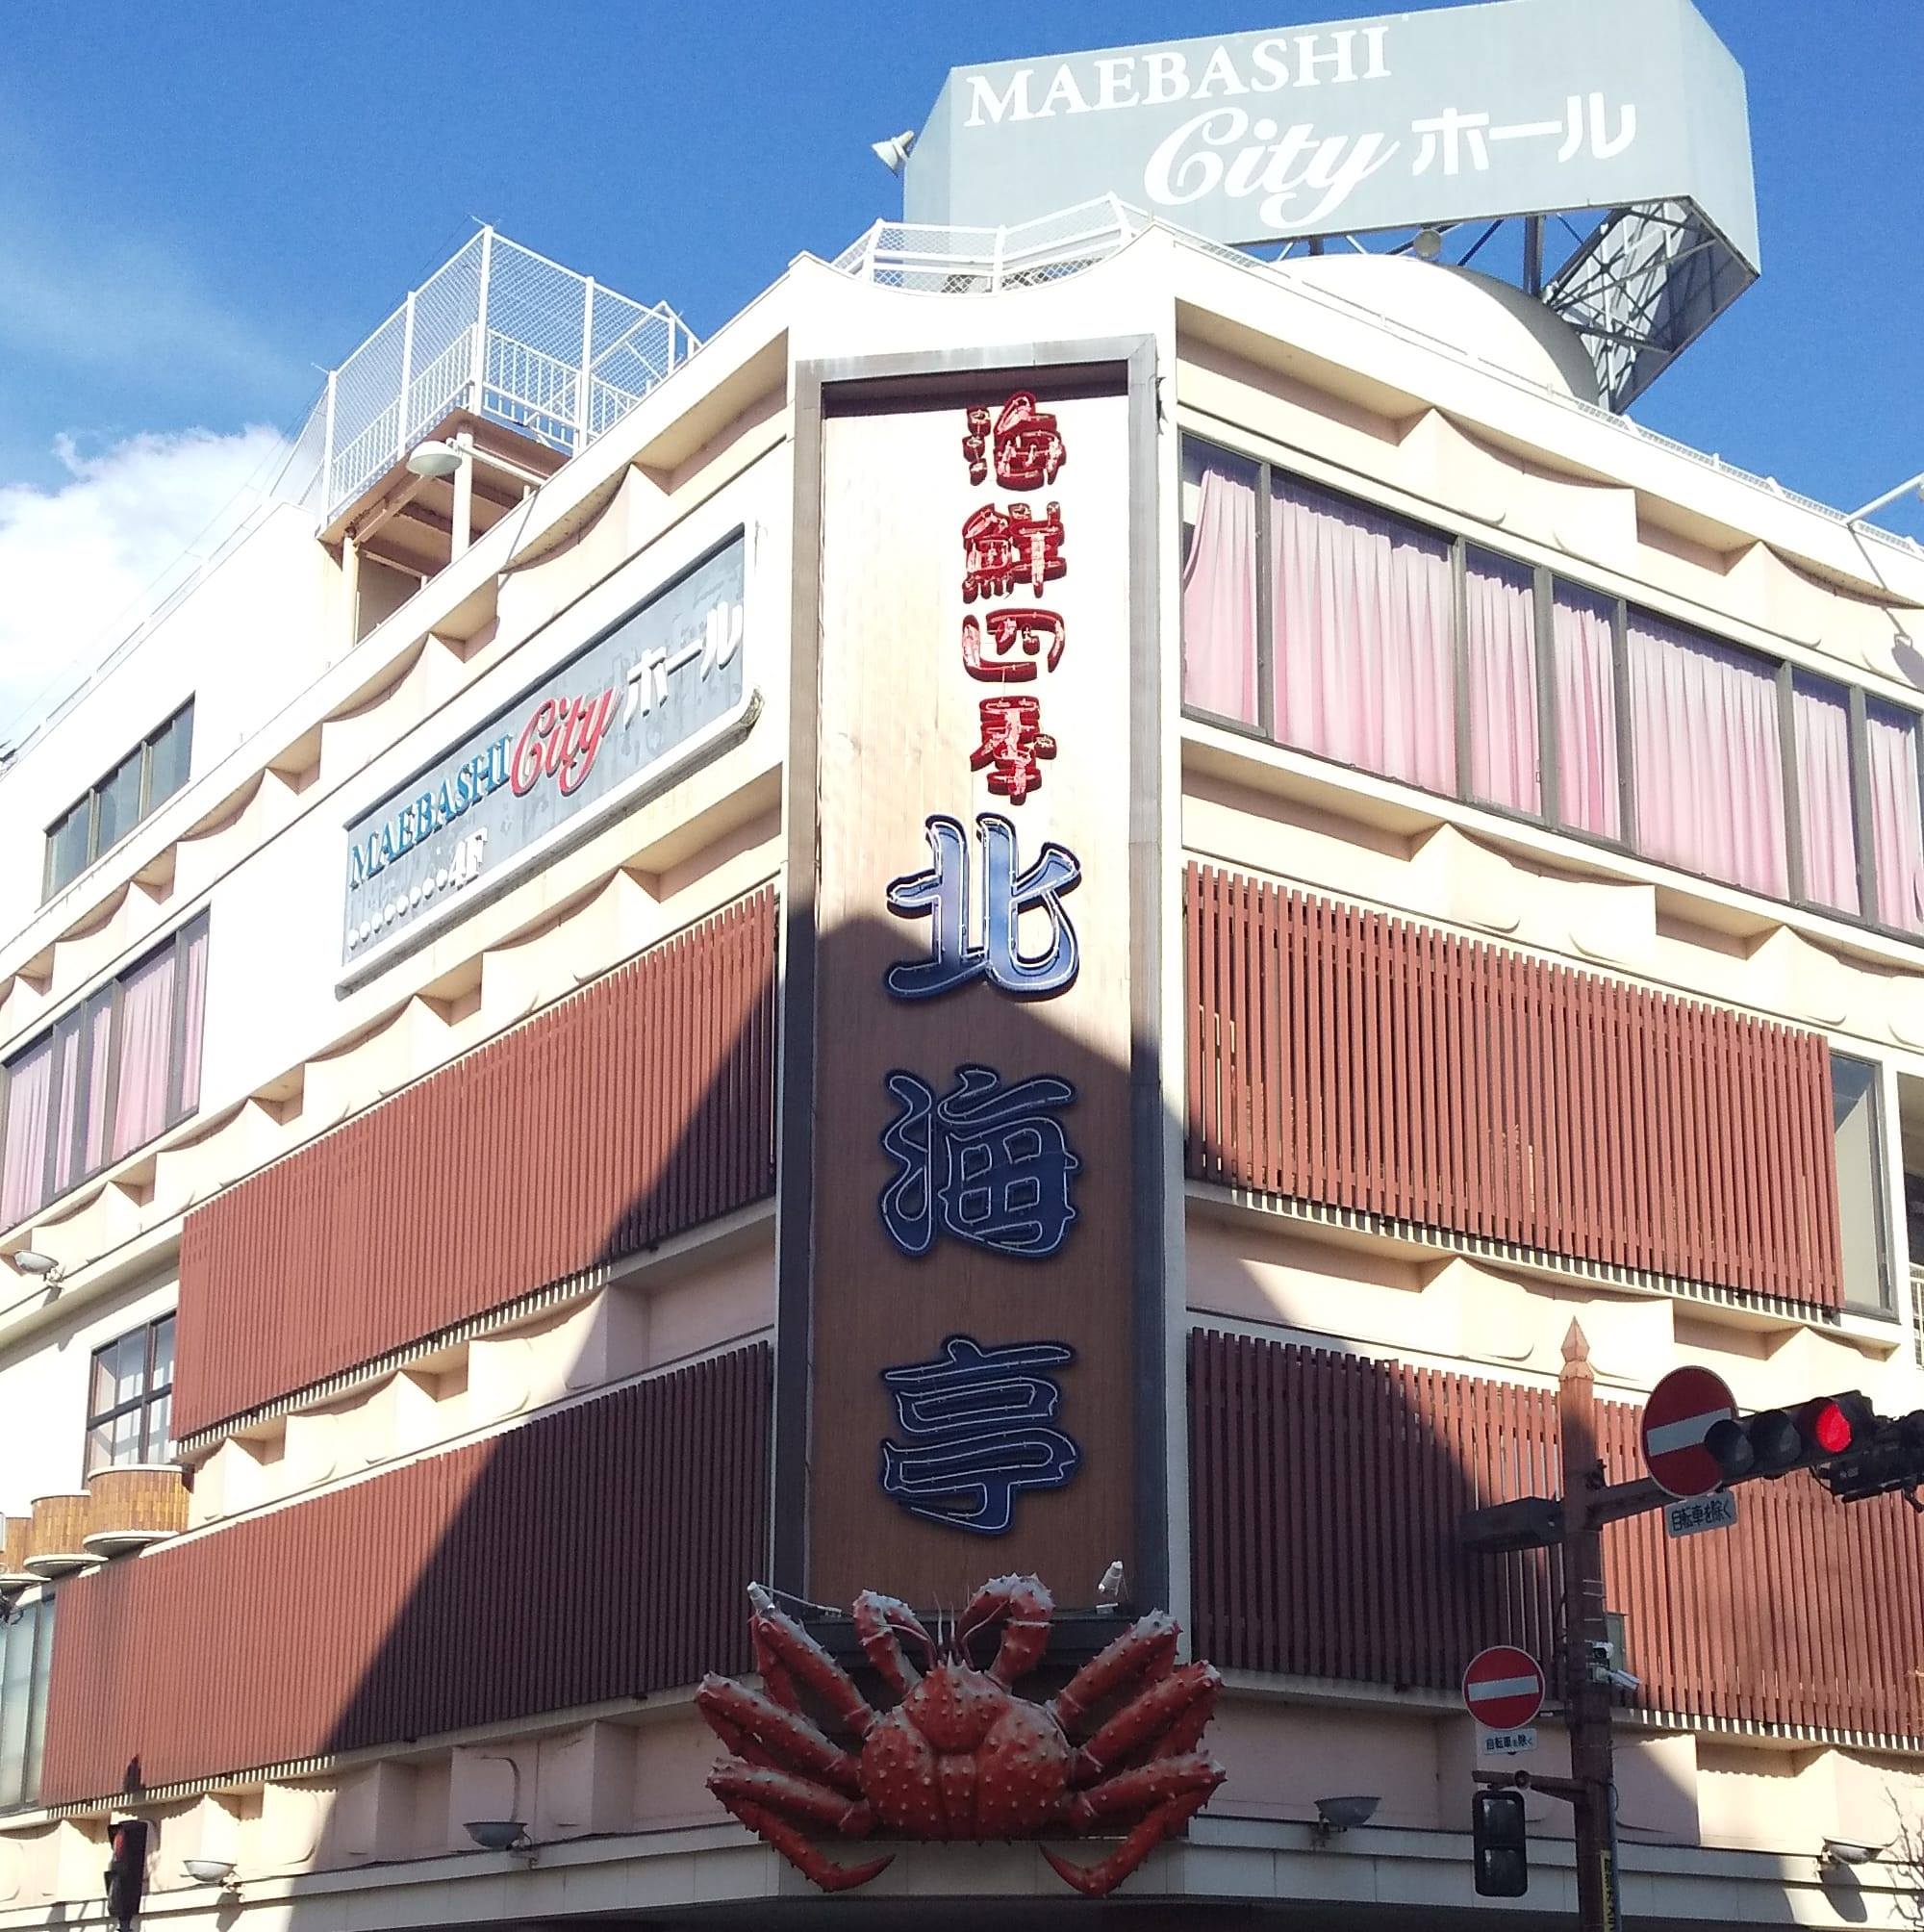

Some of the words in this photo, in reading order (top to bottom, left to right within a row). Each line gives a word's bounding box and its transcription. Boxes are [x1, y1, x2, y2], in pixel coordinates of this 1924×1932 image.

[965, 26, 1391, 128] MAEBASHI
[1143, 106, 1402, 230] City
[1411, 91, 1637, 176] ホール
[962, 391, 1067, 805] 海鮮四季
[349, 733, 513, 891] MAEBASHI
[510, 686, 623, 798] City
[623, 600, 744, 731] ホール
[881, 811, 1082, 1538] 北海亭
[1671, 1499, 1733, 1532] 自転車を除く
